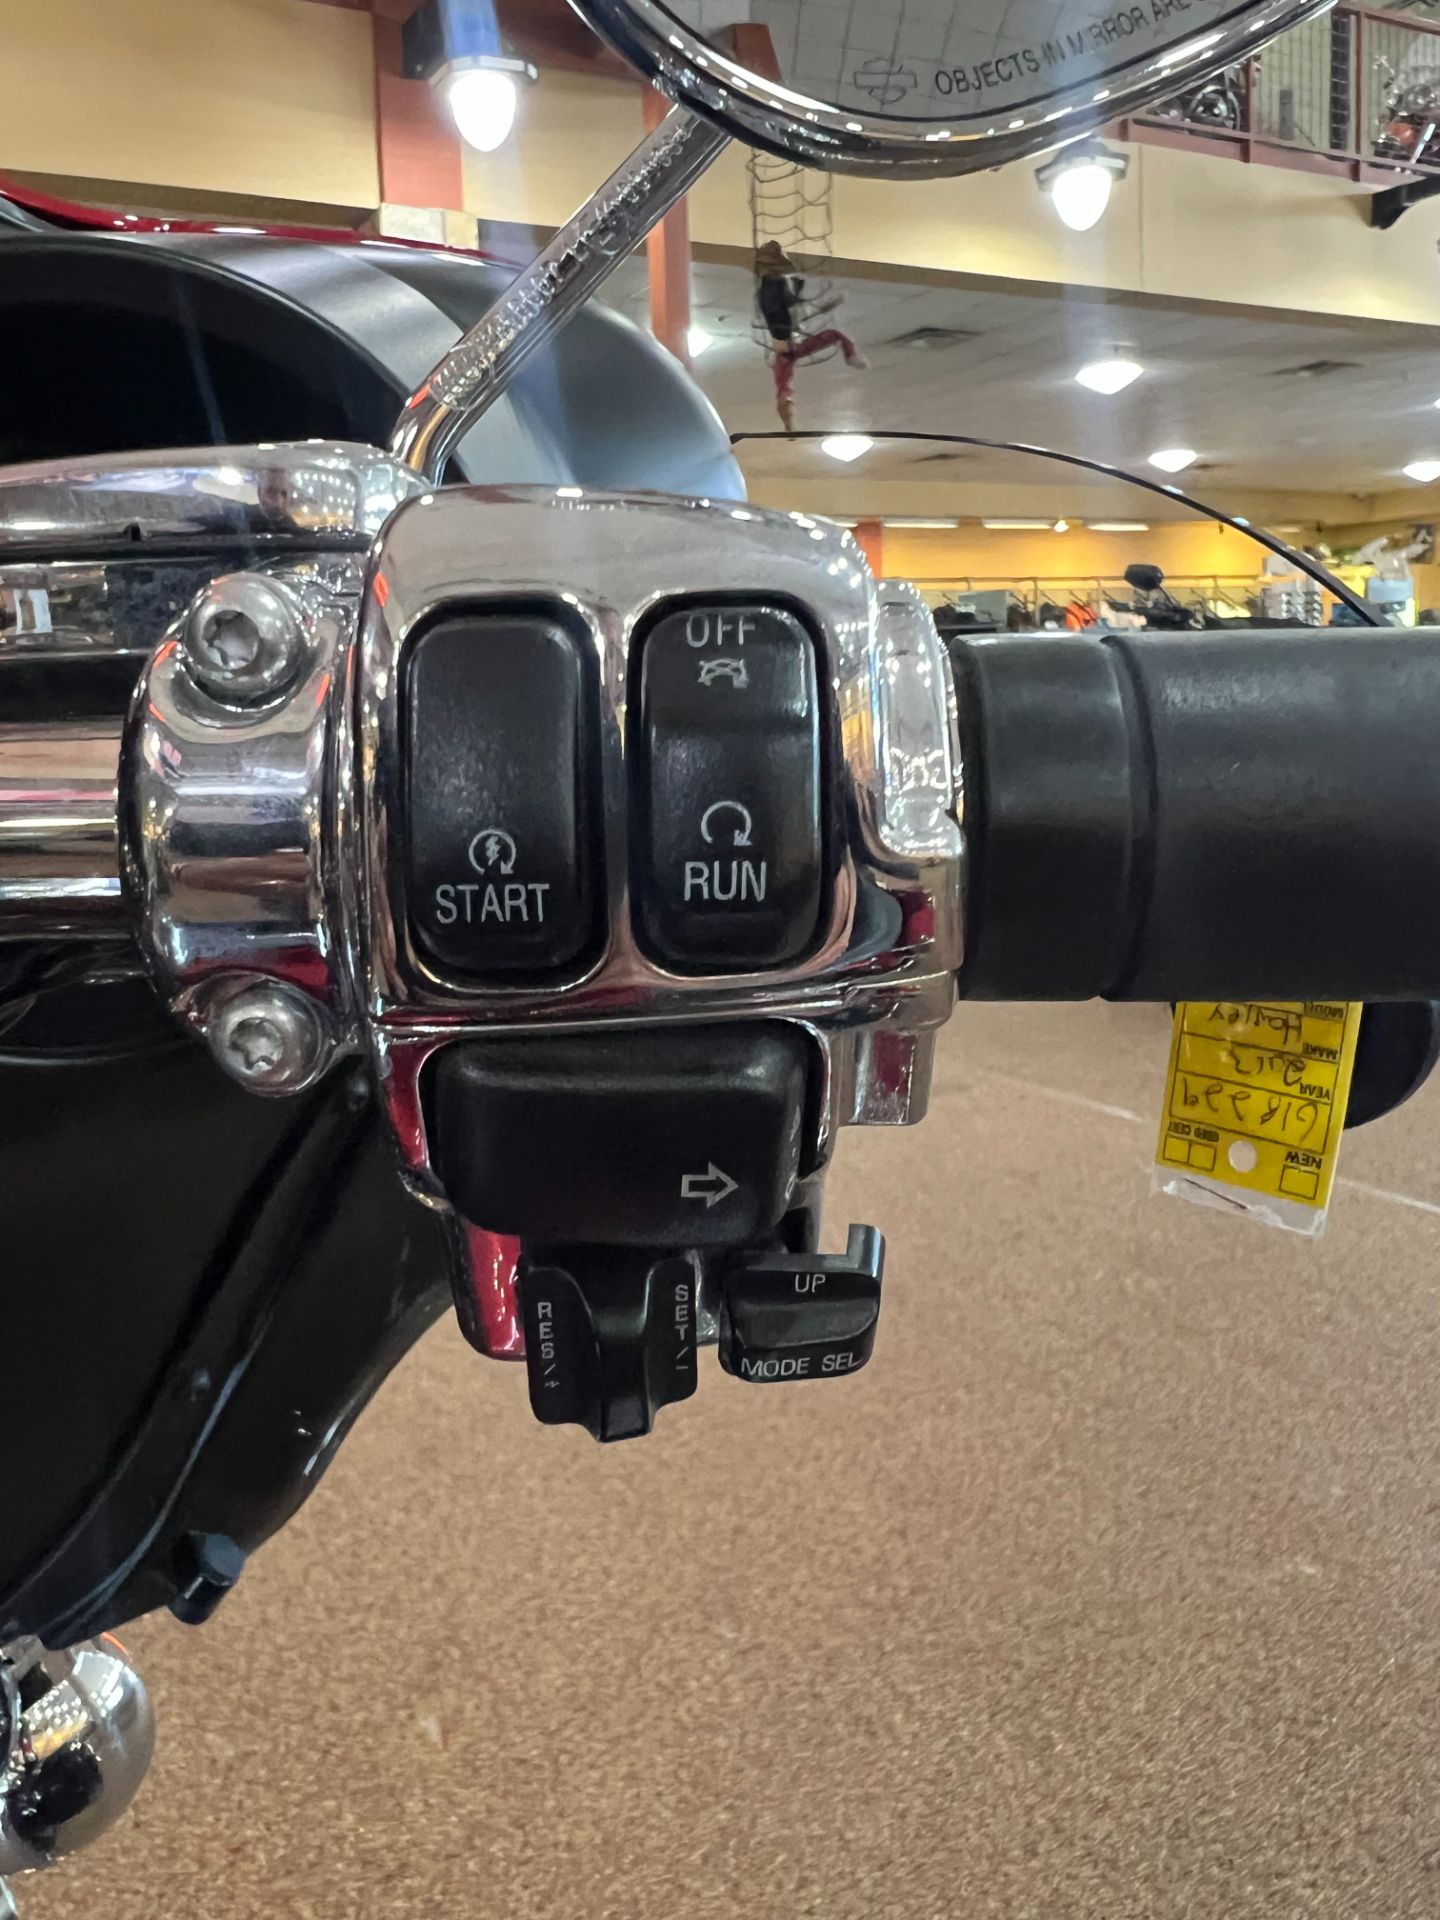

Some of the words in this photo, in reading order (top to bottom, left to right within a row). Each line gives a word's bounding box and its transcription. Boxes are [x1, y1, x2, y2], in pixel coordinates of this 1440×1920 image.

[935, 49, 1040, 95] OBJECTS
[1041, 39, 1066, 66] IN
[1066, 6, 1149, 56] MRROR
[686, 615, 756, 647] OFF
[684, 861, 767, 901] RUN
[436, 883, 550, 923] START
[1299, 1084, 1331, 1100] YEAR
[1284, 1151, 1322, 1169] NEW
[794, 1273, 826, 1293] UP
[741, 1357, 810, 1378] MODE
[821, 1352, 858, 1372] SEL
